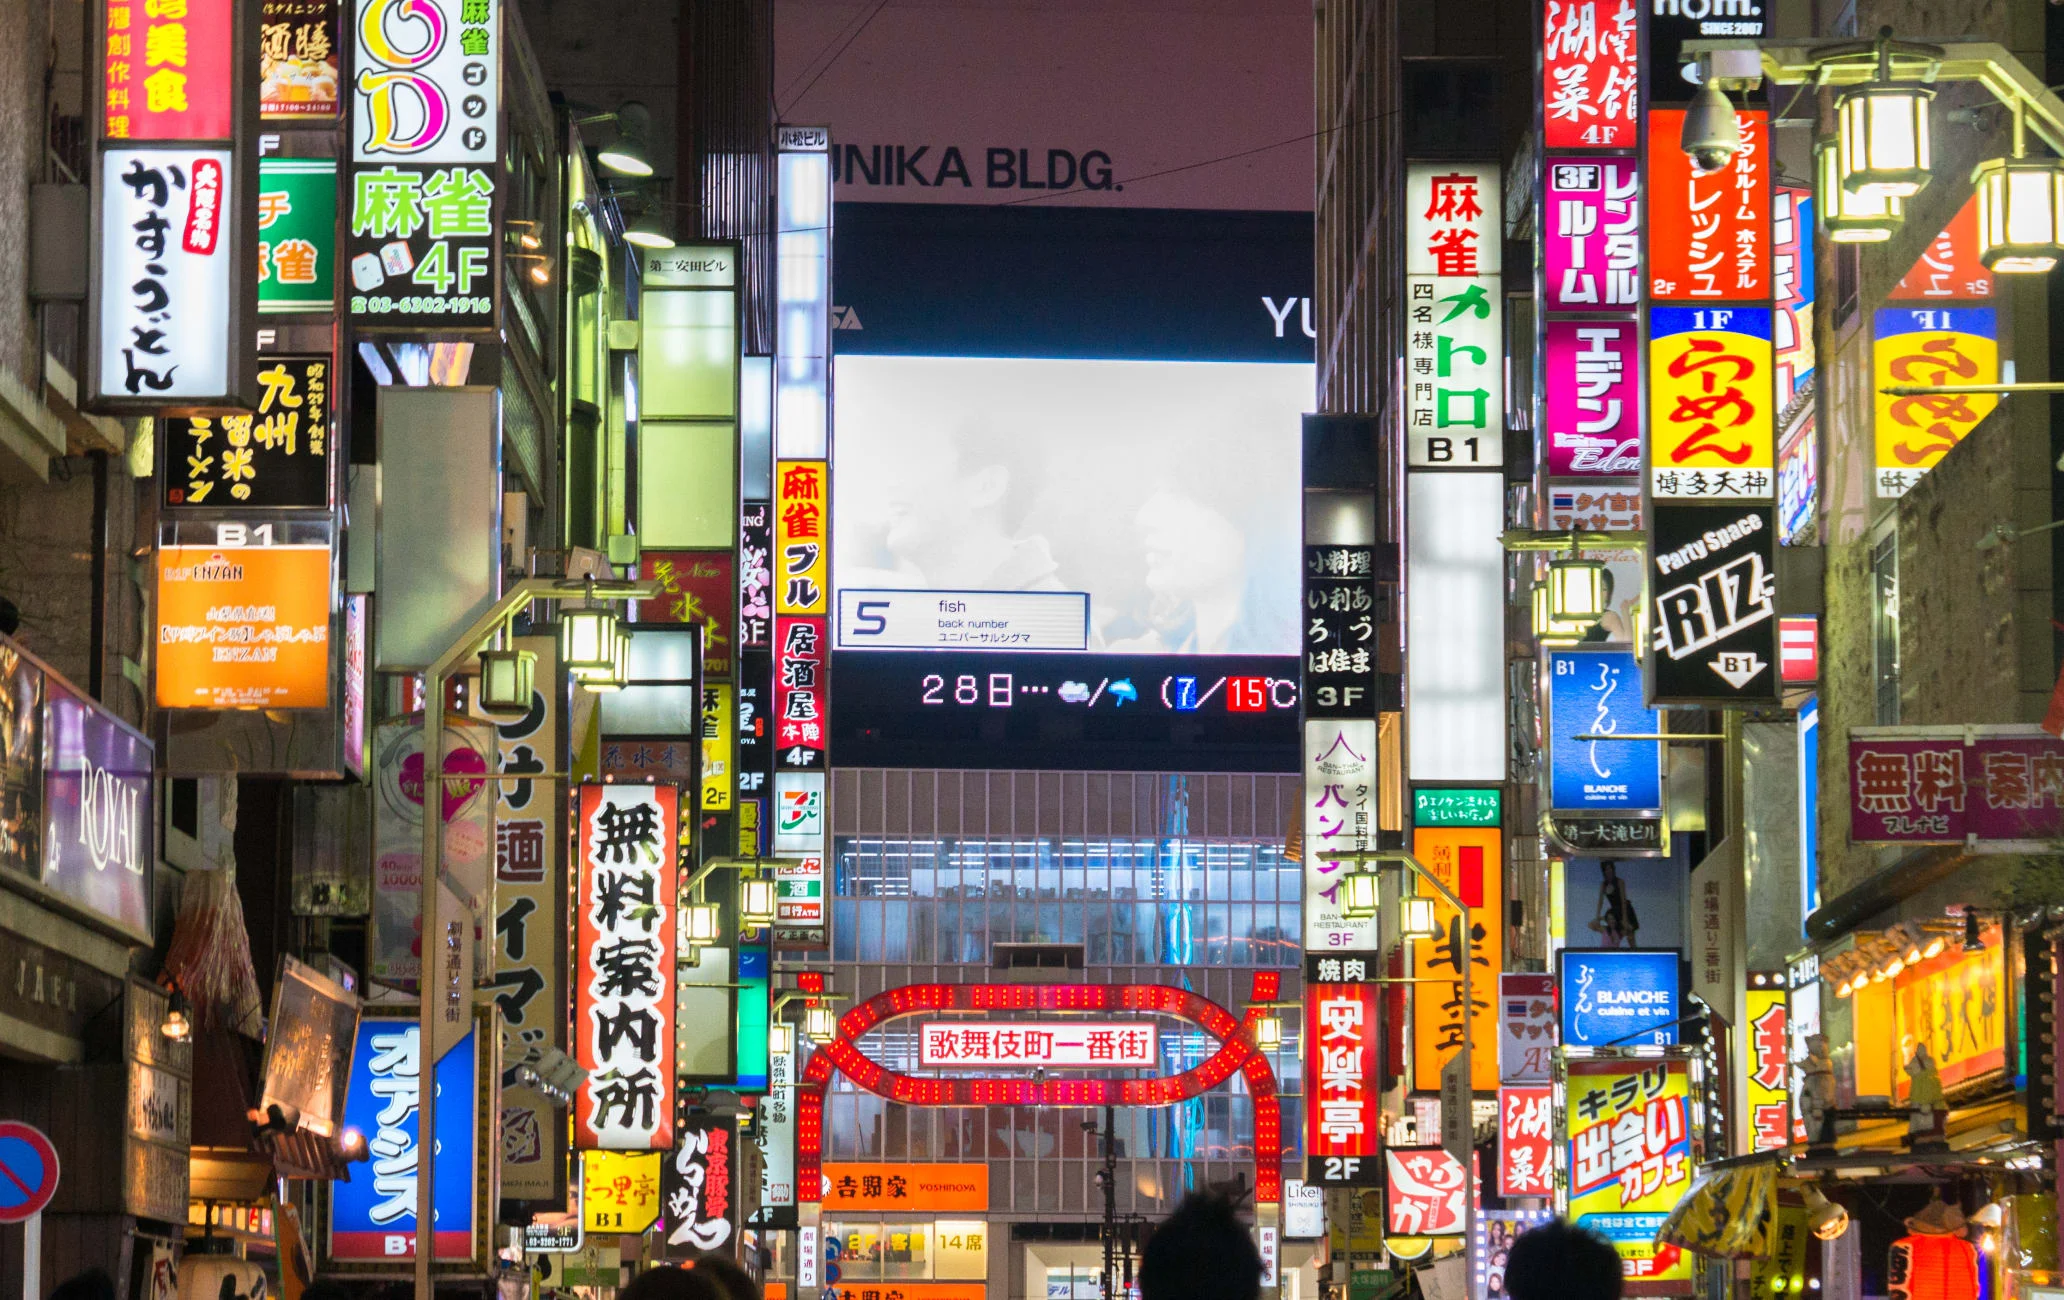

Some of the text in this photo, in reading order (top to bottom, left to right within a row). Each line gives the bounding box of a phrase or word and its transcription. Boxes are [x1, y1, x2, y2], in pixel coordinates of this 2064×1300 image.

[780, 130, 825, 147] 小松ビル
[1580, 124, 1619, 145] 4F
[986, 147, 1124, 192] BLDG.
[1556, 165, 1596, 190] 3F
[352, 166, 494, 238] 麻雀
[1735, 114, 1757, 290] レンタルルーム ホステル
[1423, 172, 1484, 277] 麻雀
[1603, 165, 1639, 305] レンタル
[1686, 169, 1726, 297] レッシュ
[1558, 200, 1599, 304] ルーム
[121, 159, 187, 395] かすうどん
[412, 241, 489, 294] 4F
[650, 259, 728, 273] 第二安田ビル
[1653, 279, 1677, 296] 2F
[368, 296, 492, 314] 03-6302-1916
[1692, 310, 1733, 330] 1F
[1412, 283, 1434, 428] 四名様専門店
[1436, 284, 1491, 429] メトロ
[1575, 327, 1623, 434] エデン
[256, 364, 303, 455] 九州
[1667, 337, 1757, 465] らーめん
[186, 416, 214, 503] ラーメン
[1427, 437, 1479, 462] B1
[1657, 471, 1769, 496] 博多天神
[217, 523, 273, 546] B1
[1655, 512, 1764, 576] Party Space
[1308, 549, 1372, 576] 小料理
[853, 601, 890, 635] 5
[938, 600, 967, 613] fish
[938, 618, 1009, 629] back number
[938, 632, 1031, 644] ユニバーサルシグマ
[783, 622, 820, 721] 居酒屋
[1555, 660, 1576, 676] B1
[1723, 656, 1753, 674] B1
[1316, 686, 1365, 707] 3F
[781, 723, 820, 742] 本陣
[786, 747, 816, 766] 4F
[705, 787, 728, 805] 2F
[1584, 784, 1628, 794] BLANCHE
[79, 756, 145, 877] ROYAL
[1355, 783, 1369, 851] タイ国料理
[1563, 824, 1657, 841] 第一大滝ビル
[1313, 921, 1369, 929] RESTAURANT
[1702, 880, 1721, 985] 劇場通り一番街
[1328, 932, 1355, 946] 3F
[595, 800, 661, 1131] 無料案内所
[1317, 959, 1366, 982] 焼肉
[1597, 990, 1670, 1004] BLANCHE
[1597, 1007, 1671, 1017] cuisine et vin
[928, 1030, 1149, 1061] 歌舞伎町一番街
[1654, 1031, 1672, 1045] B1
[1319, 995, 1364, 1144] 安楽亭
[1578, 1064, 1667, 1121] キラリ
[1577, 1098, 1683, 1190] 出会い
[1324, 1157, 1360, 1180] 2F
[1620, 1152, 1686, 1204] カフェ
[836, 1175, 977, 1198] 吉野家 YOSHINOYA
[939, 1234, 983, 1252] 14席
[803, 1231, 814, 1283] 劇場通り
